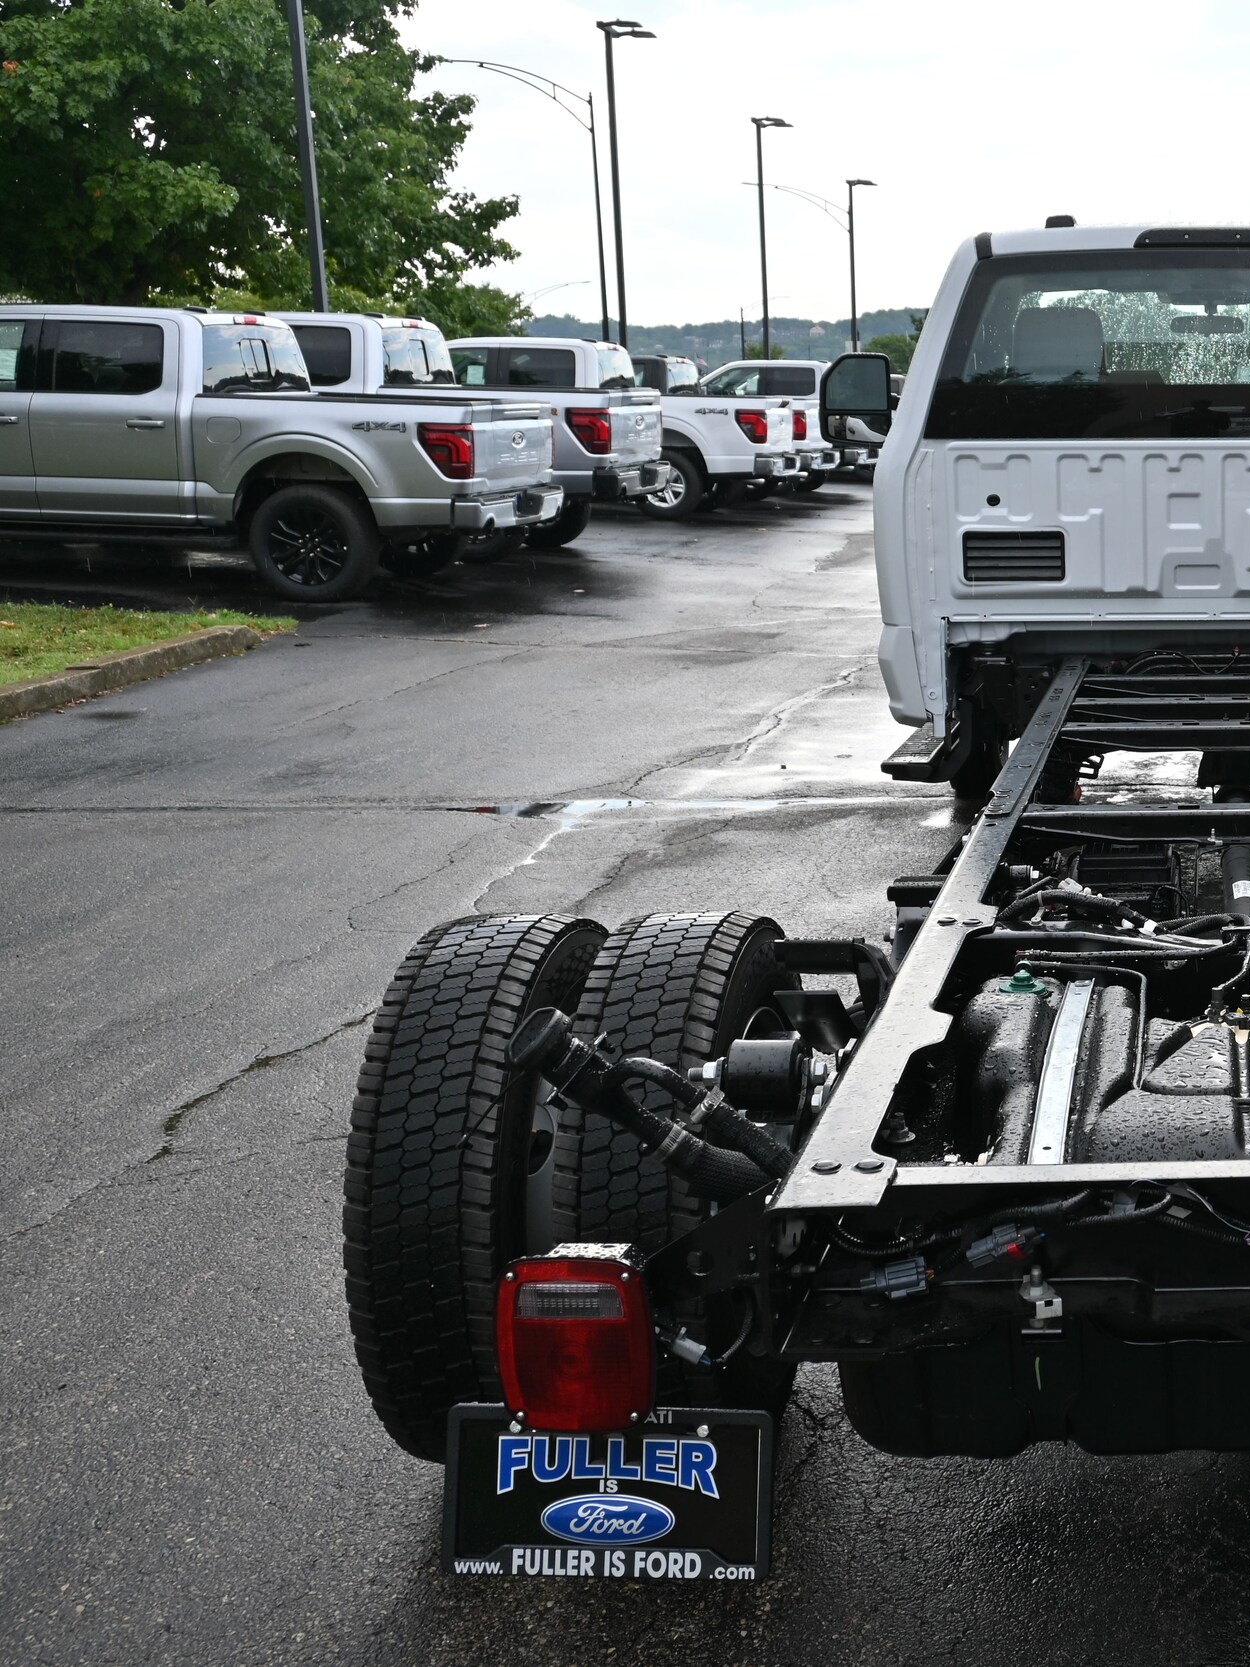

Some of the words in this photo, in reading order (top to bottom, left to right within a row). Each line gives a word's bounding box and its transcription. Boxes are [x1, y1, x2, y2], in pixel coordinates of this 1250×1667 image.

[497, 1435, 720, 1499] FULLER
[600, 1480, 618, 1493] IS
[569, 1503, 647, 1535] Ford
[454, 1560, 503, 1574] www.
[512, 1549, 594, 1576] FULLER
[604, 1551, 625, 1578] IS
[634, 1551, 702, 1579] FORD
[709, 1566, 755, 1580] .com
